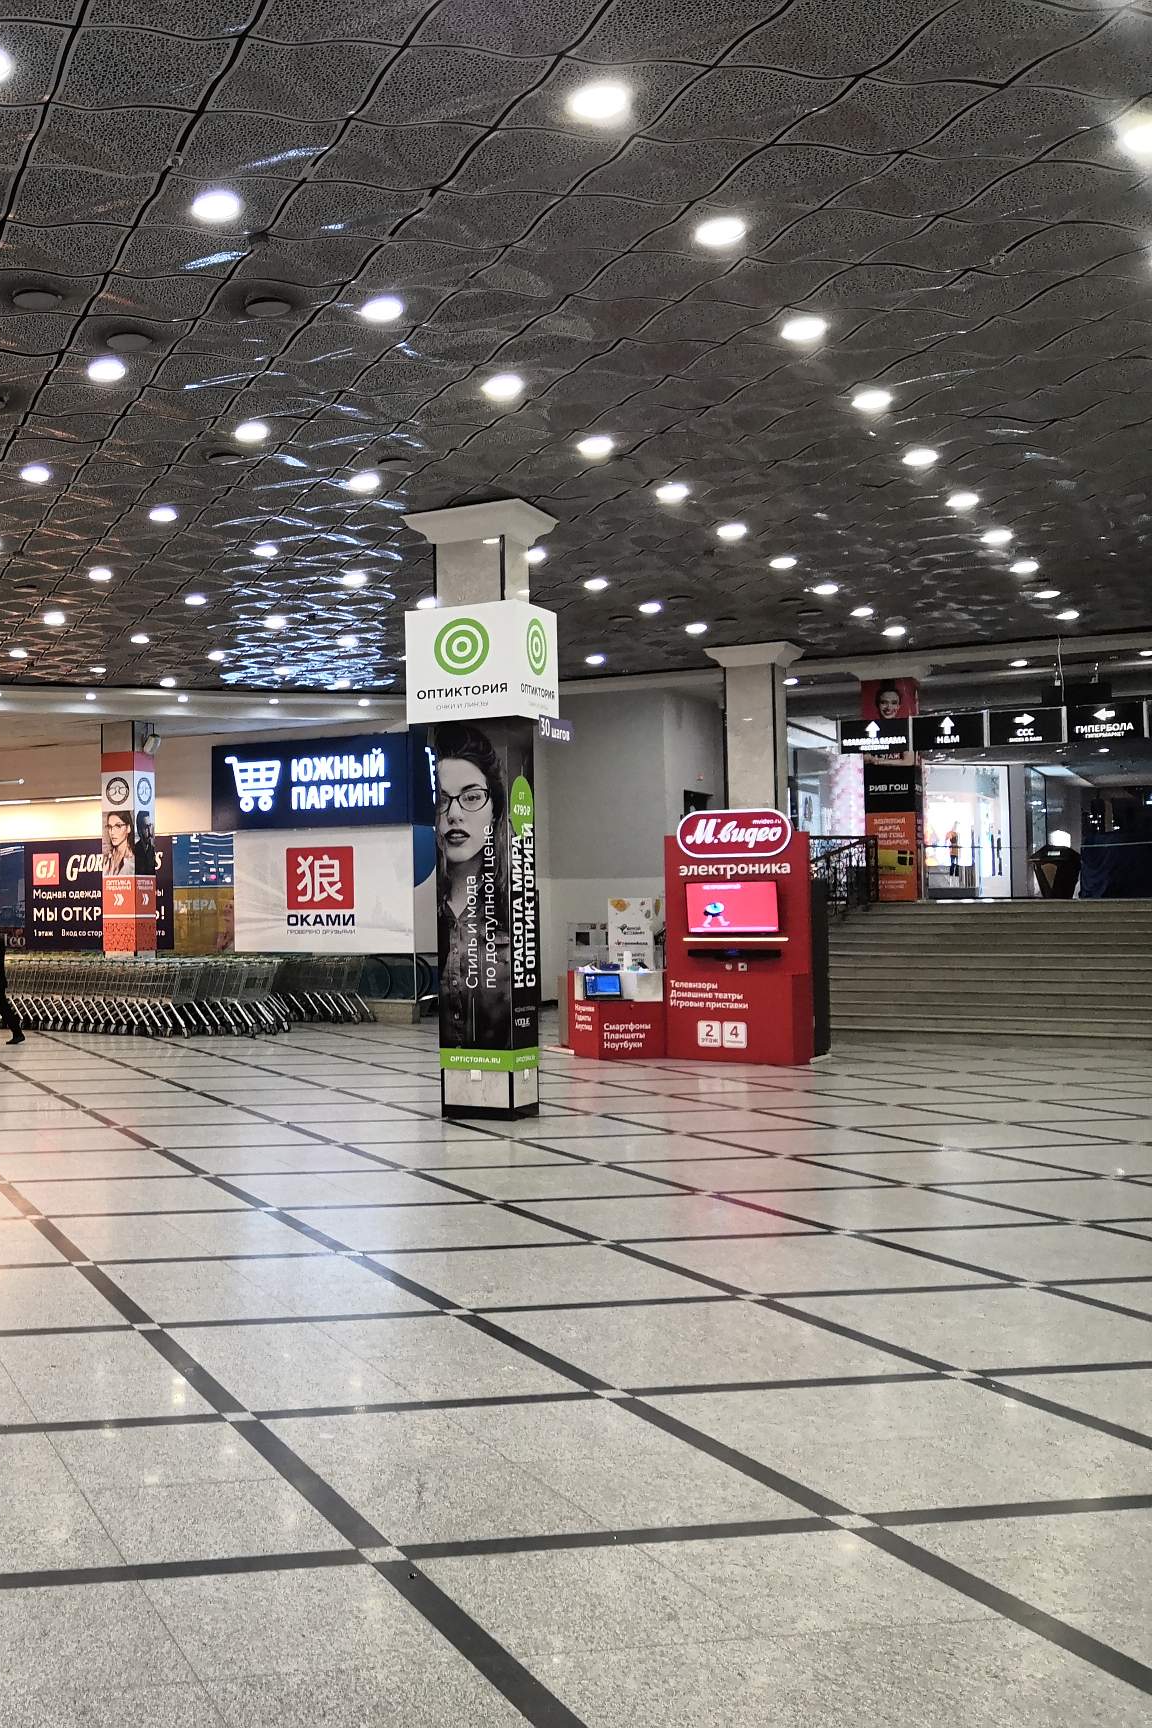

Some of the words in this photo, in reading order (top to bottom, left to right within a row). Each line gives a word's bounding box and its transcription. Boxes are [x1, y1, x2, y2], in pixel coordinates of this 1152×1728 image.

[416, 682, 508, 700] ОПТИКТОРИЯ
[520, 682, 555, 700] ОПТИКТОРИЯ
[540, 717, 551, 737] 30
[551, 727, 571, 742] шагов
[1075, 722, 1135, 734] ГИПЕРБОЛА
[936, 735, 960, 744] H&M
[291, 748, 385, 783] ЮЖНЫЙ
[869, 784, 888, 792] РИВ
[889, 783, 909, 791] ГОШ
[291, 782, 391, 810] ПАРКИНГ
[484, 825, 497, 868] цене
[512, 834, 524, 893] МИРА
[679, 862, 791, 879] электроника
[297, 855, 344, 902] 狼
[33, 889, 67, 900] Модная
[68, 888, 102, 899] одежда
[466, 875, 478, 917] мода
[521, 823, 536, 972] ОПТИКТОРИЕЙ
[33, 907, 58, 922] МЫ
[61, 906, 102, 921] ОТКР
[286, 914, 355, 926] ОКАМИ
[483, 874, 498, 965] доступной
[87, 931, 103, 939] стор
[512, 898, 525, 989] КРАСОТА
[466, 936, 479, 989] Стиль
[486, 967, 497, 989] по
[526, 975, 536, 988] С
[669, 980, 718, 990] Телевизоры
[669, 990, 713, 999] Домашние
[714, 992, 744, 1002] театры
[670, 999, 705, 1009] Игровые
[706, 1001, 749, 1010] приставки
[603, 1022, 651, 1032] Смартфоны
[705, 1023, 714, 1037] 2
[729, 1025, 739, 1039] 4
[603, 1032, 646, 1040] Планшеты
[603, 1040, 643, 1051] Ноутбуки
[450, 1055, 501, 1064] OPTICTORIA.RU
